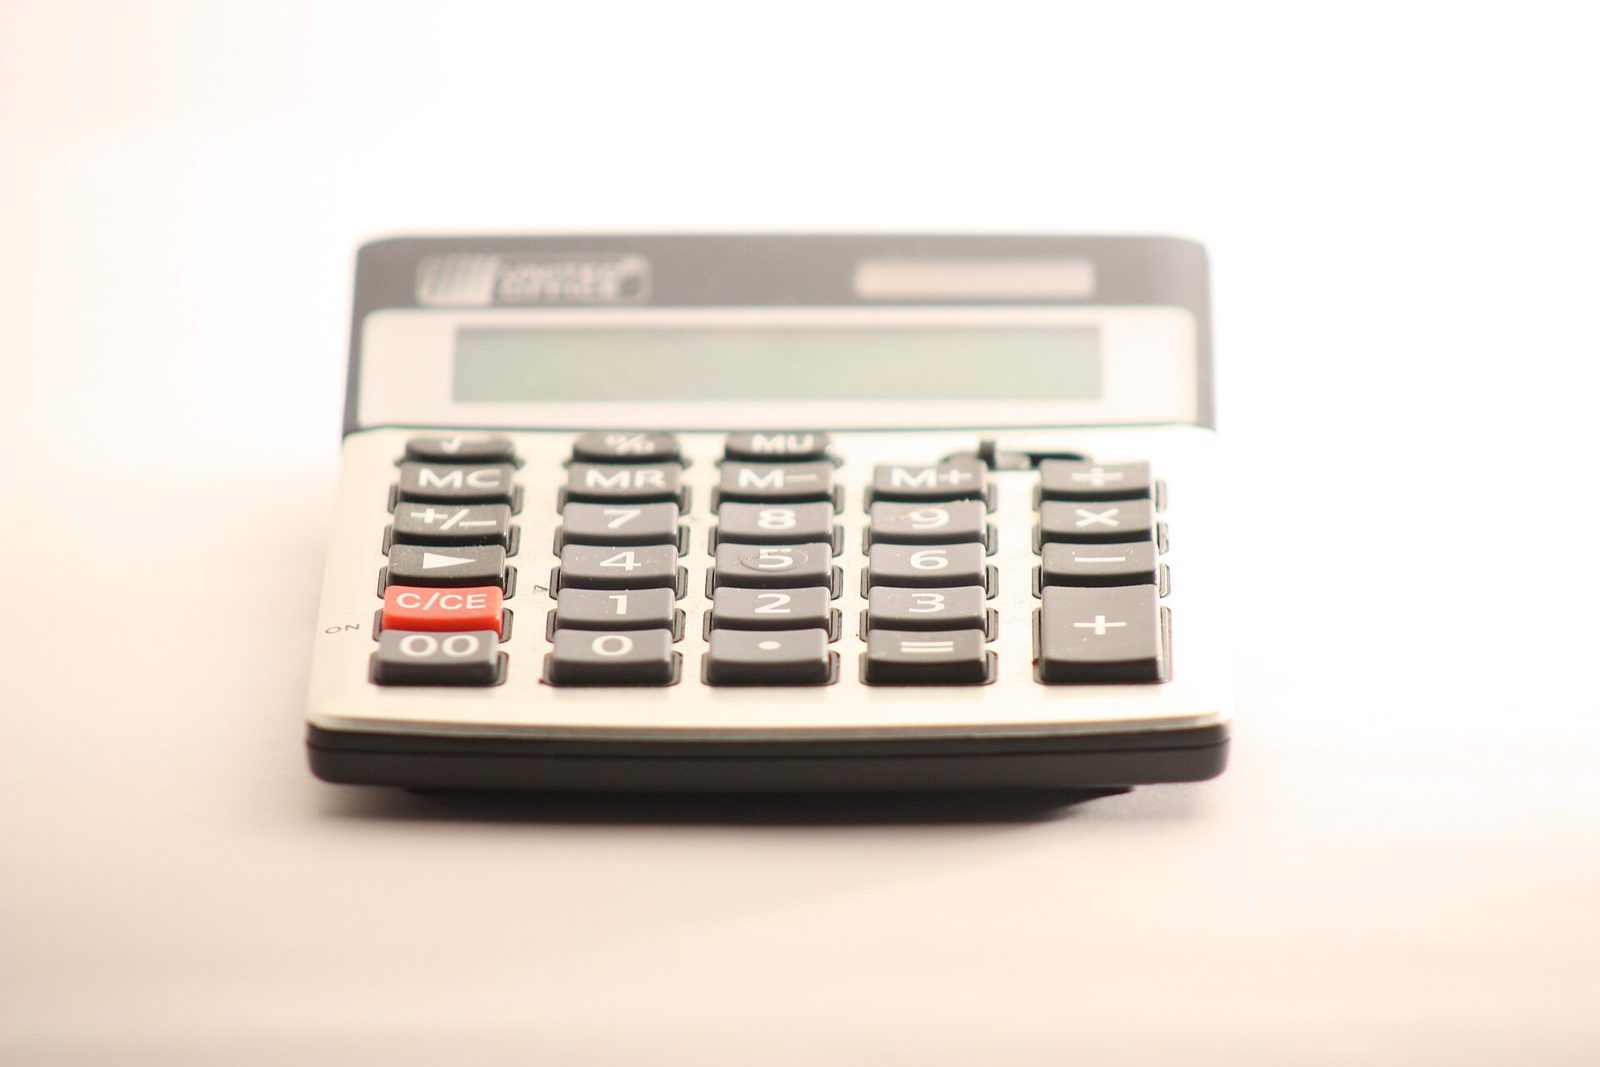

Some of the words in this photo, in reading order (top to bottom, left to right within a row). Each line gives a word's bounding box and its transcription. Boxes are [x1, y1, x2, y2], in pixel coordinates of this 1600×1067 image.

[418, 468, 500, 488] MC
[585, 469, 666, 489] MR
[890, 467, 973, 487] M+
[603, 509, 641, 529] 7
[757, 509, 796, 529] 8
[910, 509, 950, 529] 9
[599, 551, 642, 571] 4
[758, 548, 794, 569] 5
[910, 550, 949, 569] 6
[396, 592, 487, 611] C/CE
[608, 595, 628, 614] 1
[754, 594, 791, 613] 2
[908, 593, 945, 613] 3
[1073, 615, 1127, 635] +
[591, 634, 633, 656] 0
[900, 641, 954, 653] =
